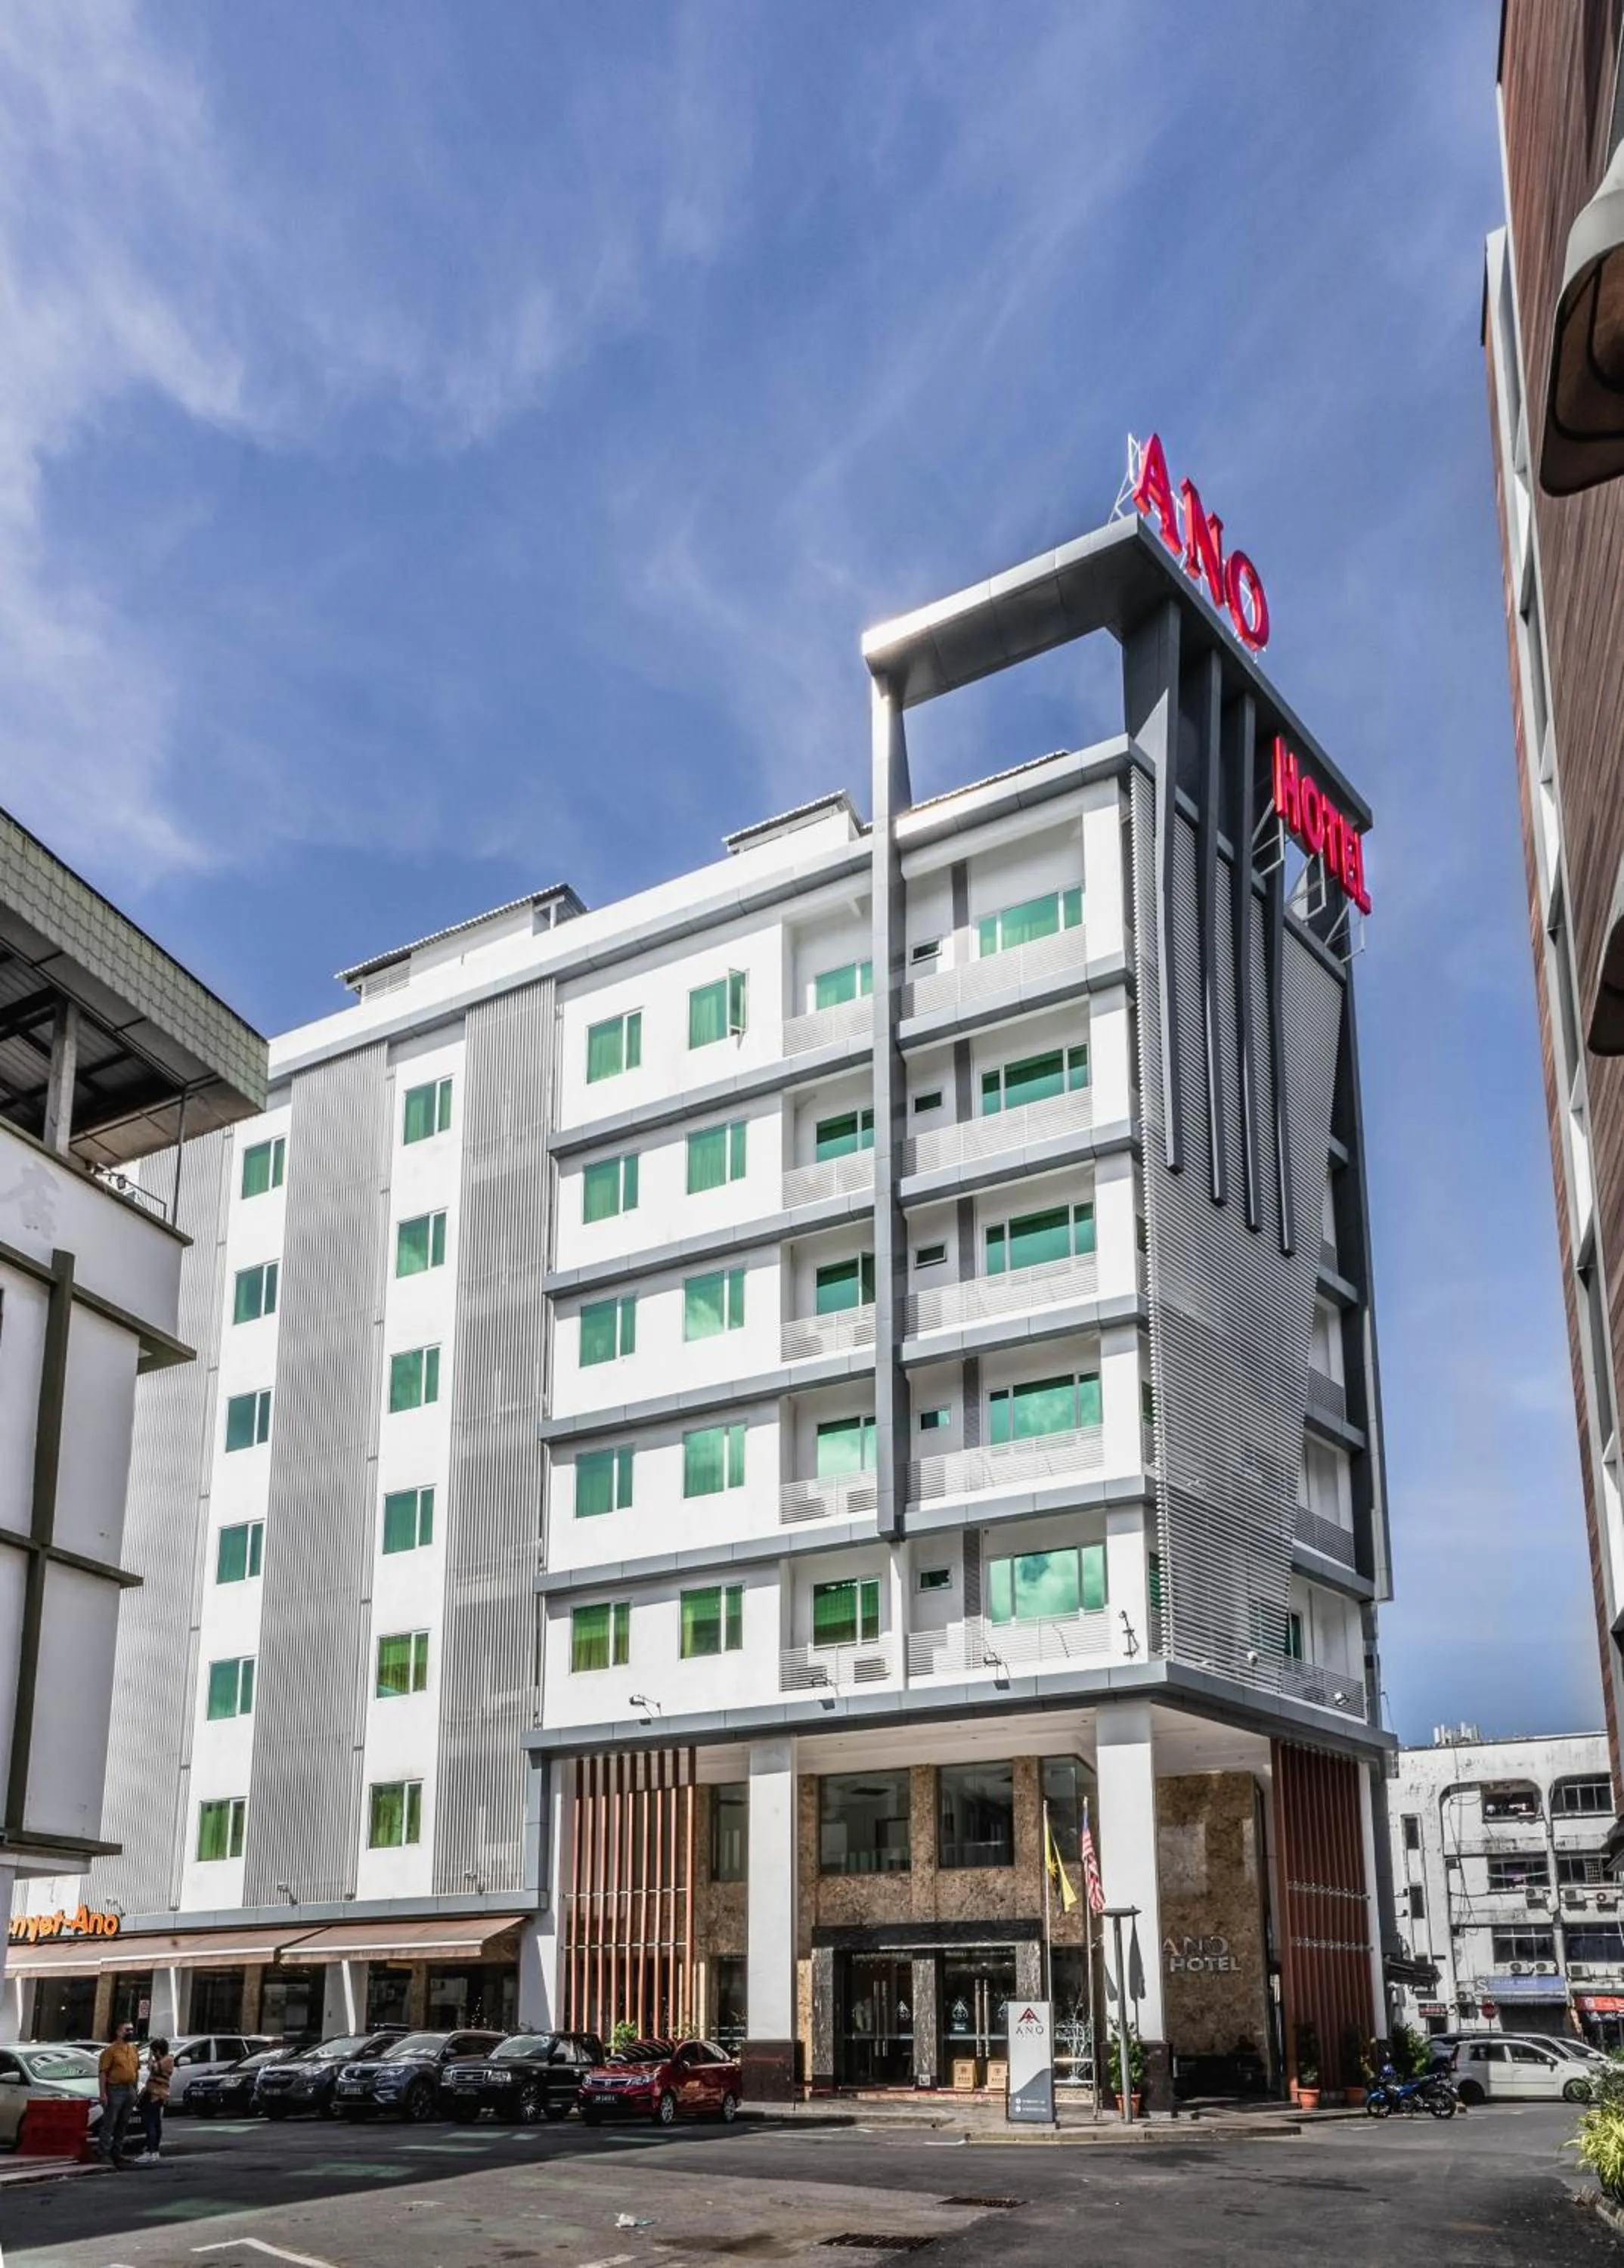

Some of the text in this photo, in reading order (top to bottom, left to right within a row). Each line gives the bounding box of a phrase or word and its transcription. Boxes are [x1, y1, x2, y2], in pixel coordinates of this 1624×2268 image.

[1132, 432, 1269, 651] ANO
[1272, 736, 1371, 916] HOTEL
[8, 1904, 119, 1943] nyet-Ano
[1162, 1935, 1229, 1957] ANO
[1170, 1956, 1242, 1972] HOTEL
[1015, 2025, 1044, 2035] ANO
